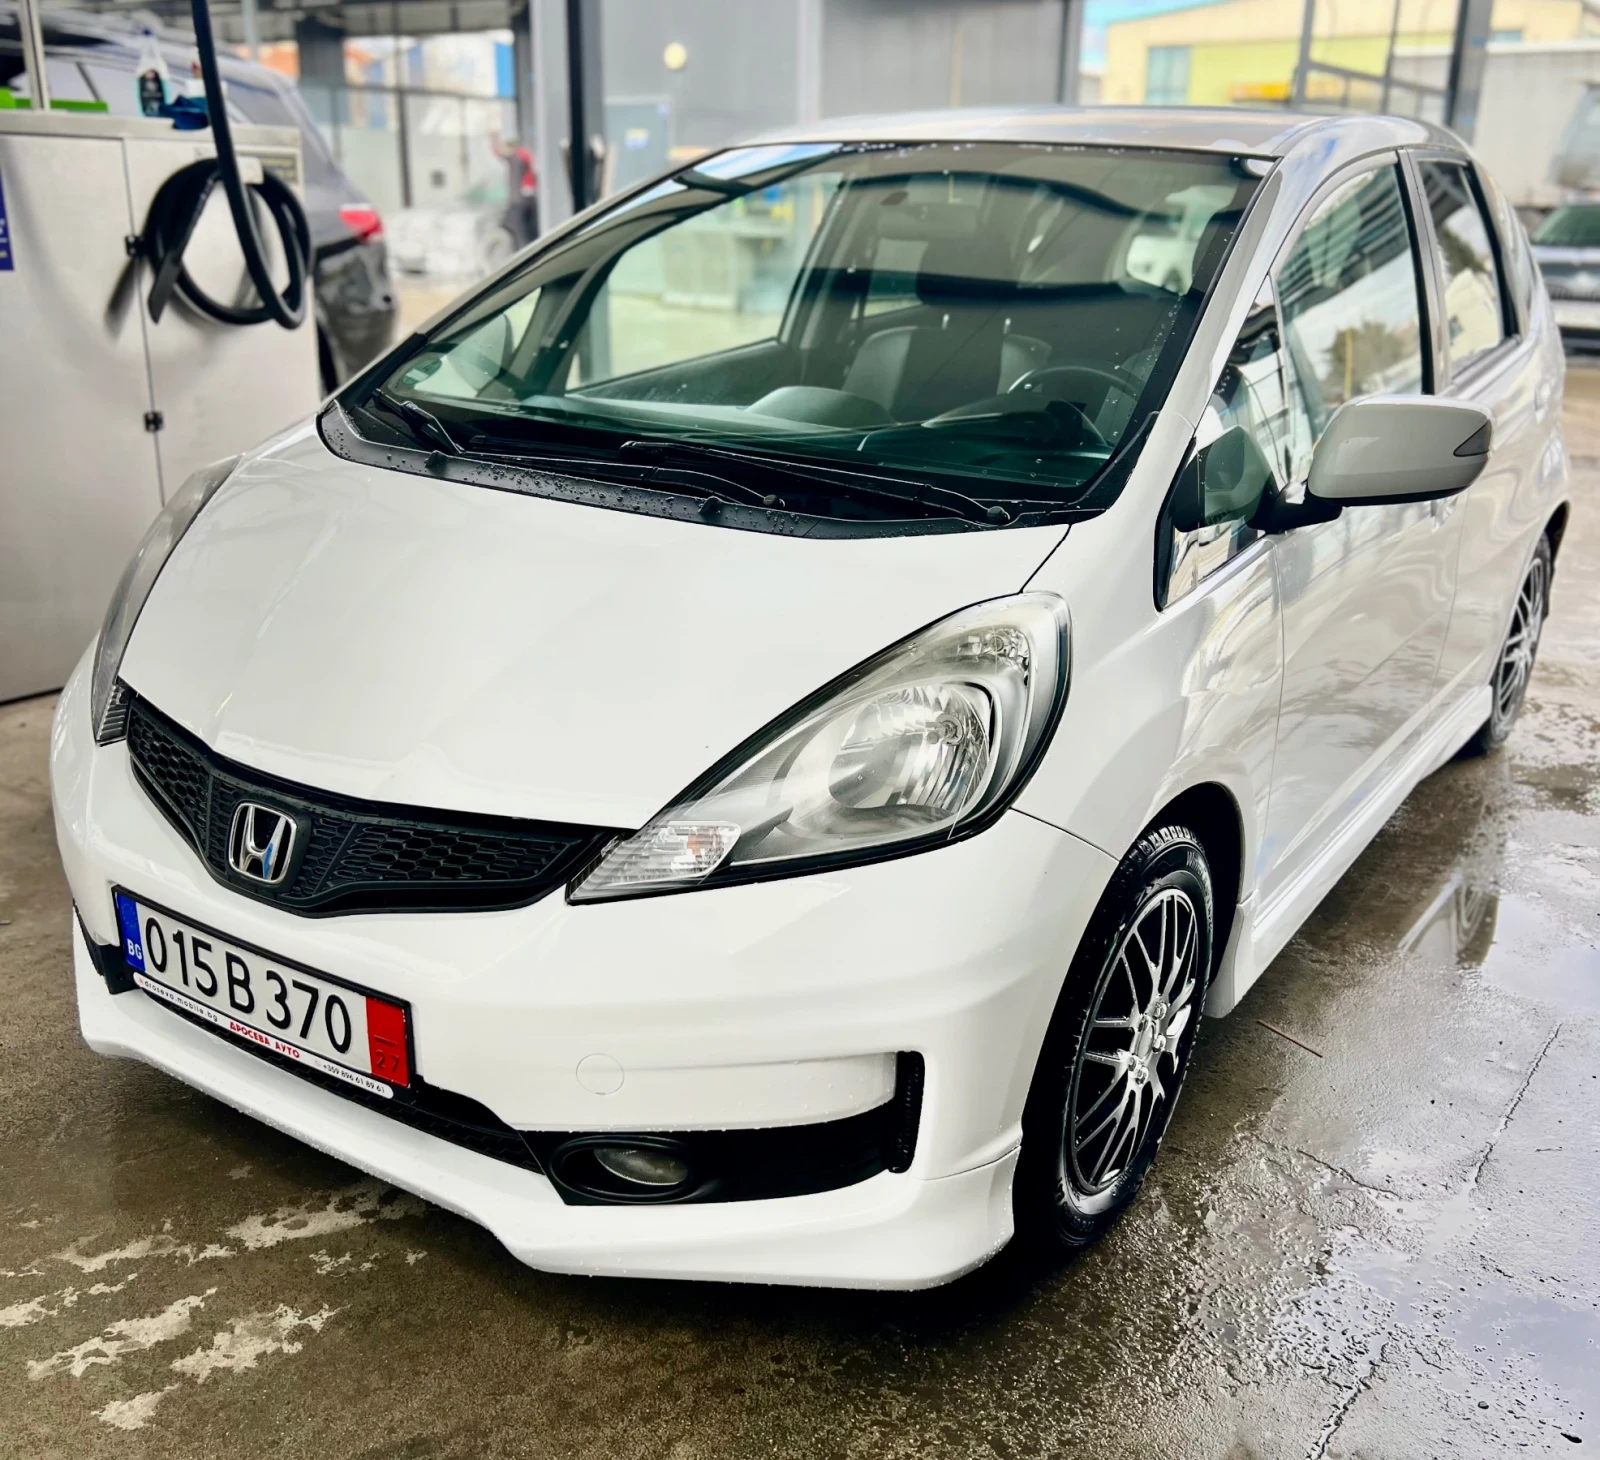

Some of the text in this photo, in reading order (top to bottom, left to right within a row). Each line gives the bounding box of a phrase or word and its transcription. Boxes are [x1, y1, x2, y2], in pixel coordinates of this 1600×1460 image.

[127, 938, 143, 960] BG
[229, 1021, 300, 1058] ДРОСЕВА АУТО
[376, 1049, 399, 1072] 27
